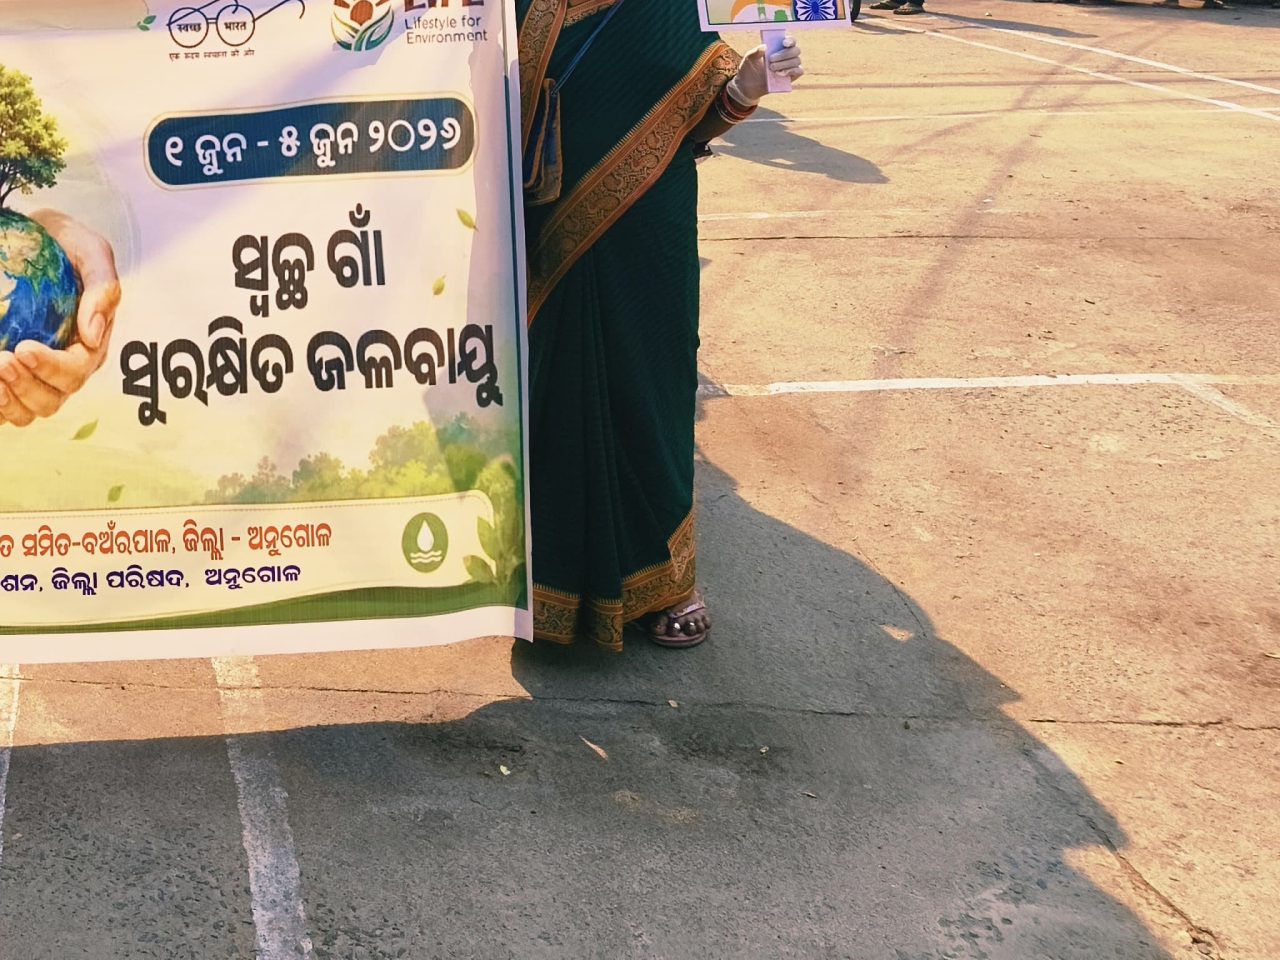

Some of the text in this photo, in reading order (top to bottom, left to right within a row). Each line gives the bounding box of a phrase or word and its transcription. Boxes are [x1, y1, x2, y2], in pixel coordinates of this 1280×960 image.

[176, 21, 247, 33] स्वच्छ भारत
[405, 14, 481, 30] Lifestyle for
[406, 29, 488, 44] Environment
[164, 136, 183, 167] ୧
[195, 131, 248, 176] ଜୁନ
[278, 125, 300, 157] ୫
[309, 120, 359, 168] ଜୁନ
[368, 116, 462, 154] ୨୦୨୬
[231, 203, 386, 318] ସ୍ୱଚ୍ଛ ଗାଁ
[120, 315, 503, 427] ସୁରକ୍ଷିତ ଜଳବାୟୁ
[183, 518, 224, 560] ଜିଲ୍ଲା
[248, 522, 332, 555] ଅନୁଗୋଳ
[51, 567, 98, 596] ଜିଲ୍ଲା
[205, 564, 301, 591] ଅନୁଗୋଳ
